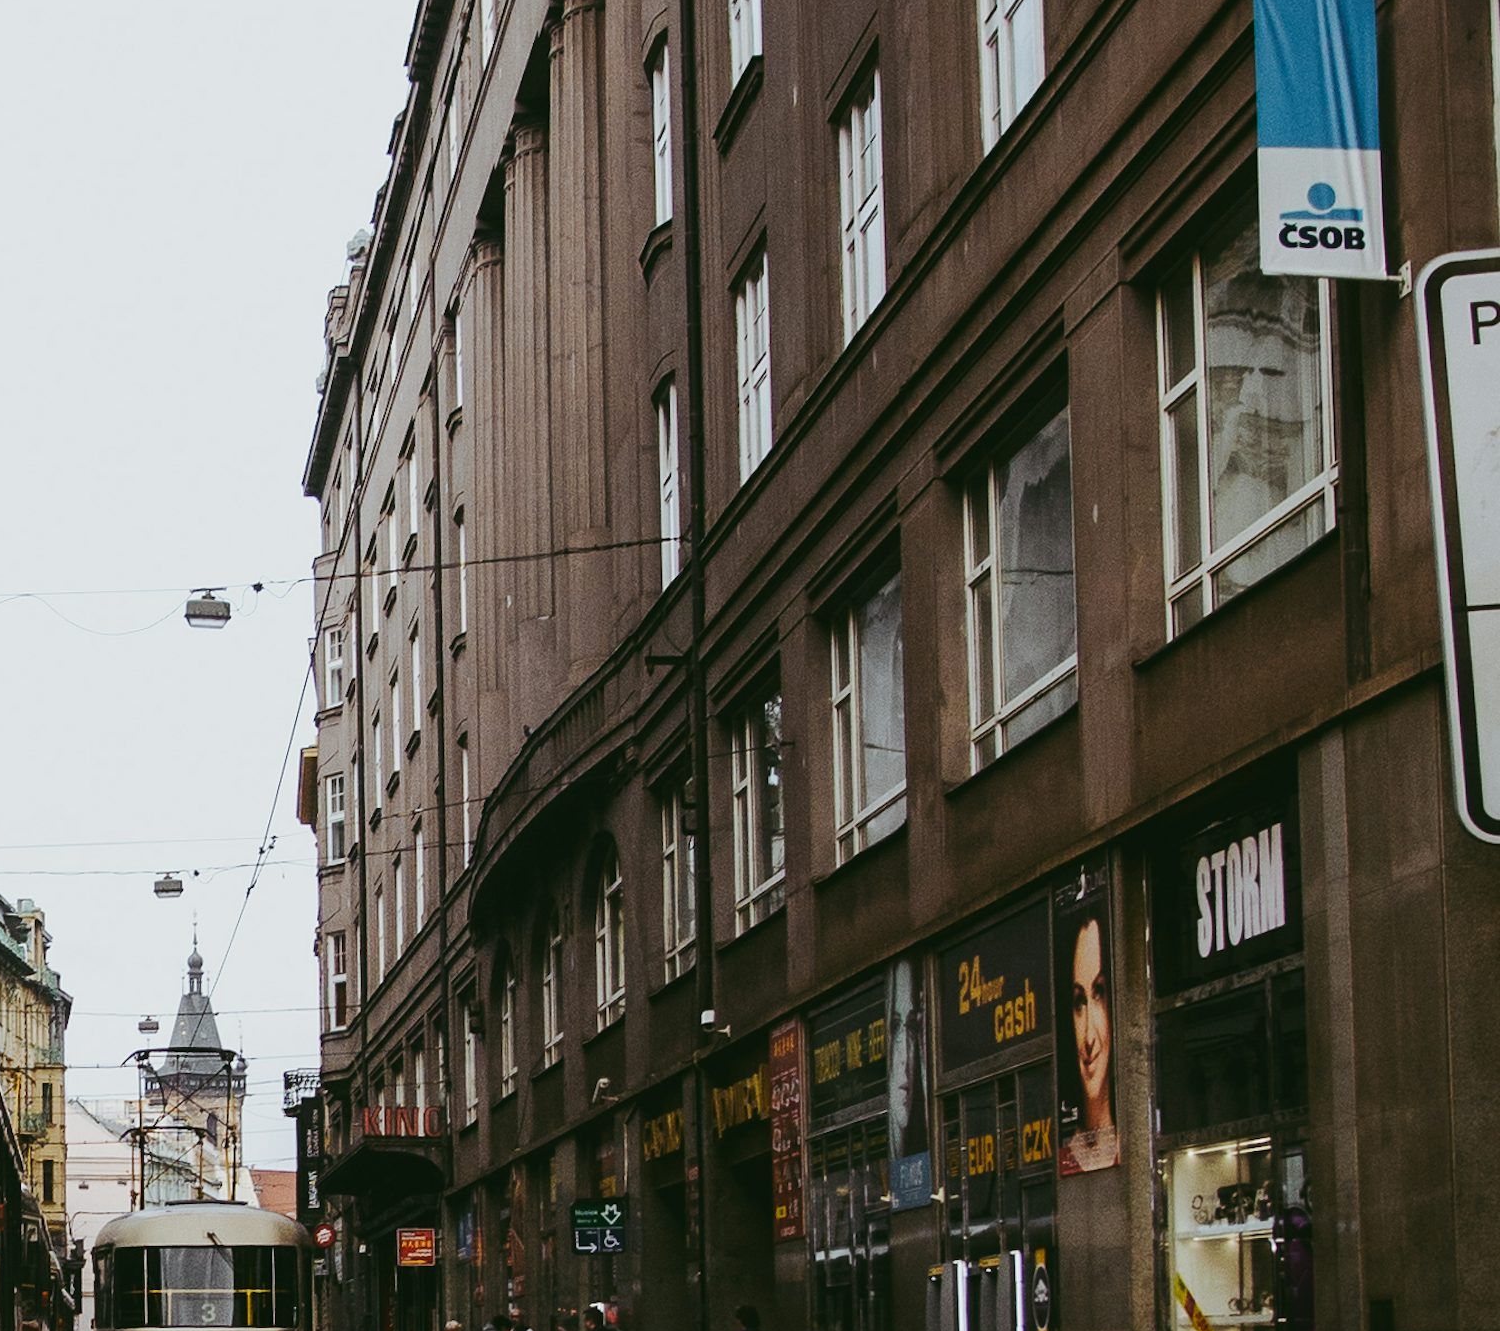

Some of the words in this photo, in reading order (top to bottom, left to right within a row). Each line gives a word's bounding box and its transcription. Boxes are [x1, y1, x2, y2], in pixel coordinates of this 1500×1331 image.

[1278, 220, 1366, 251] ČSOB
[1196, 823, 1285, 958] STORM
[957, 955, 982, 1016] 24
[993, 978, 1037, 1044] cash
[967, 1134, 994, 1176] EUR
[1022, 1117, 1053, 1163] CZK
[200, 1302, 217, 1323] 3
